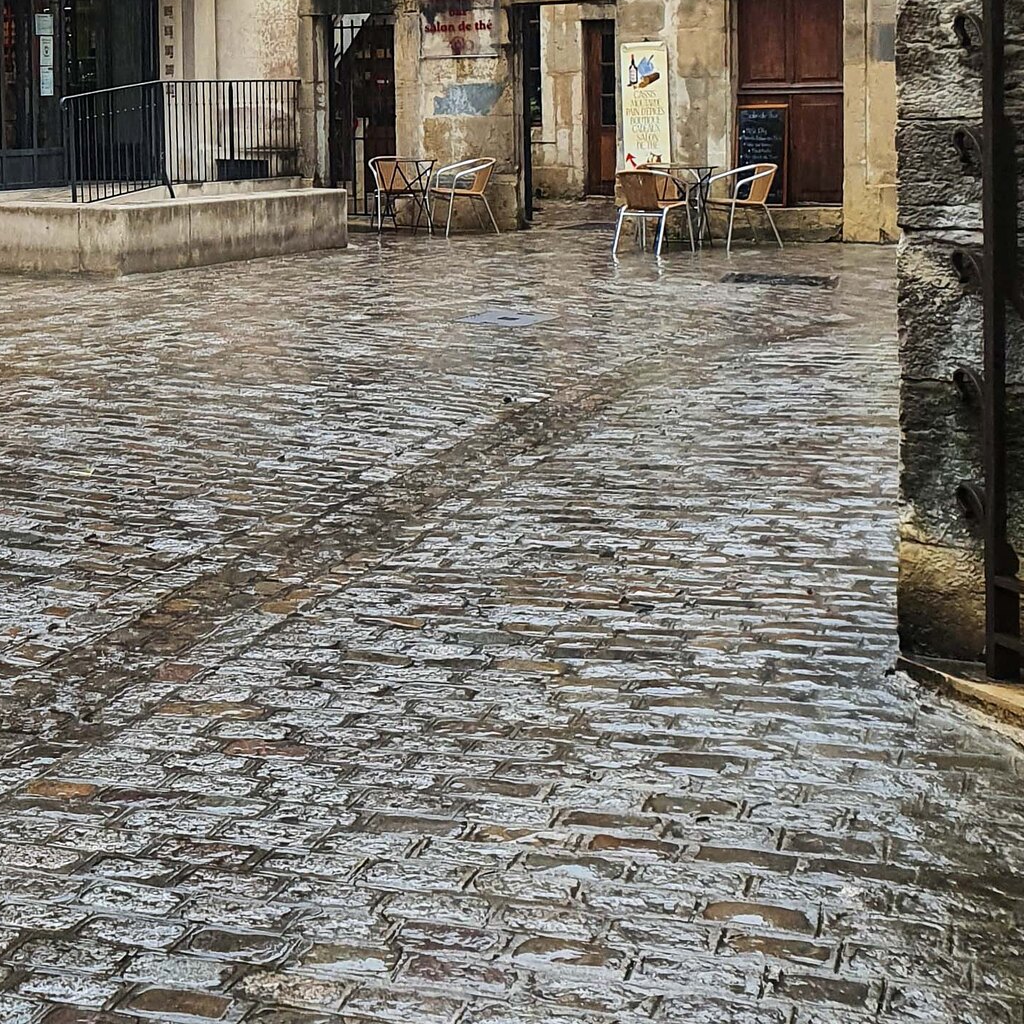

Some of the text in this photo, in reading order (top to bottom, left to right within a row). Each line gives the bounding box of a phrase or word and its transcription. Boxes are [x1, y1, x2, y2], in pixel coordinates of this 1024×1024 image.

[425, 19, 493, 33] salon de thé
